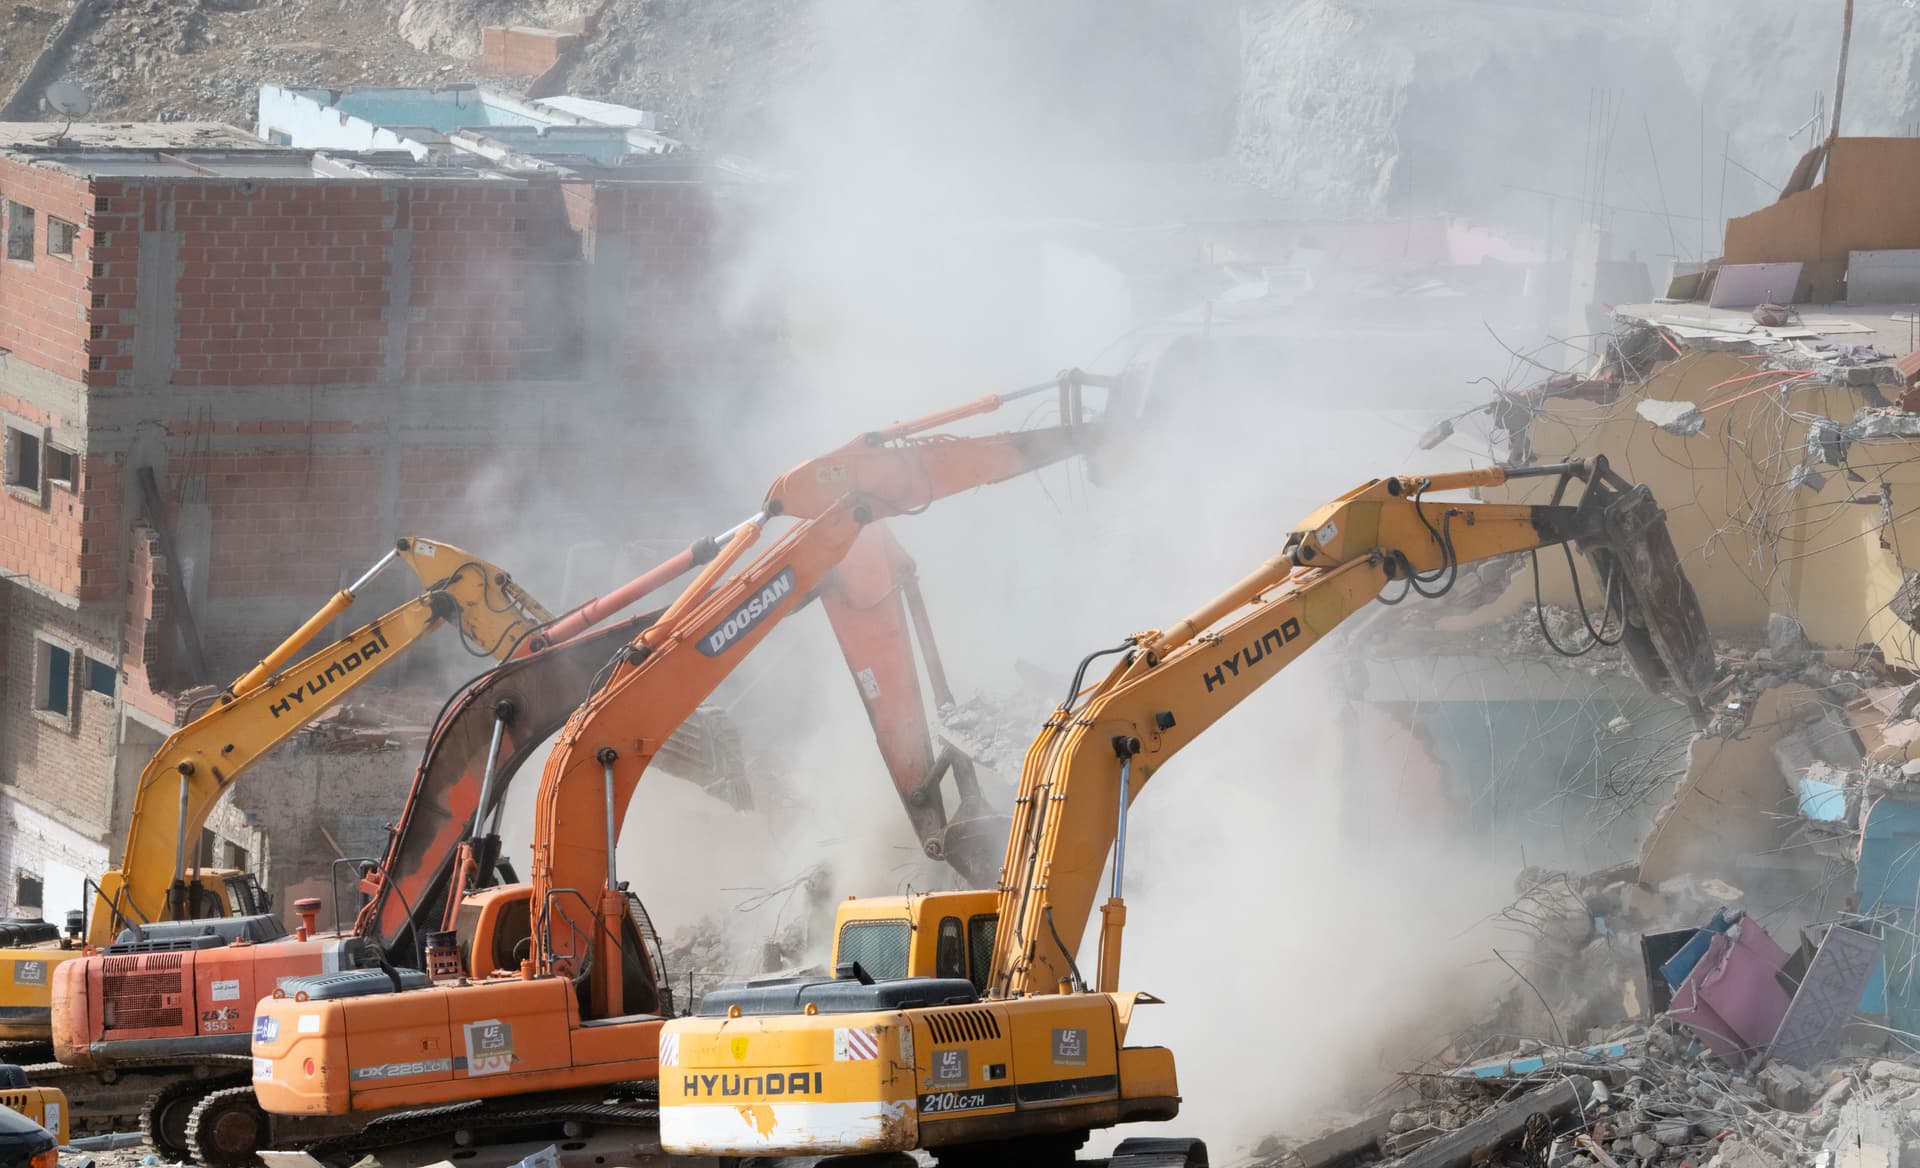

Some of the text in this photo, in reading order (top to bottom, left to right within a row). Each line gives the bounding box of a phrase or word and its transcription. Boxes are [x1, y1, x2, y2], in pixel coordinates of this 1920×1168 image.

[710, 574, 791, 653] DOOSAN
[269, 626, 389, 718] HYUNDAI
[683, 1071, 822, 1097] HYUNDAI
